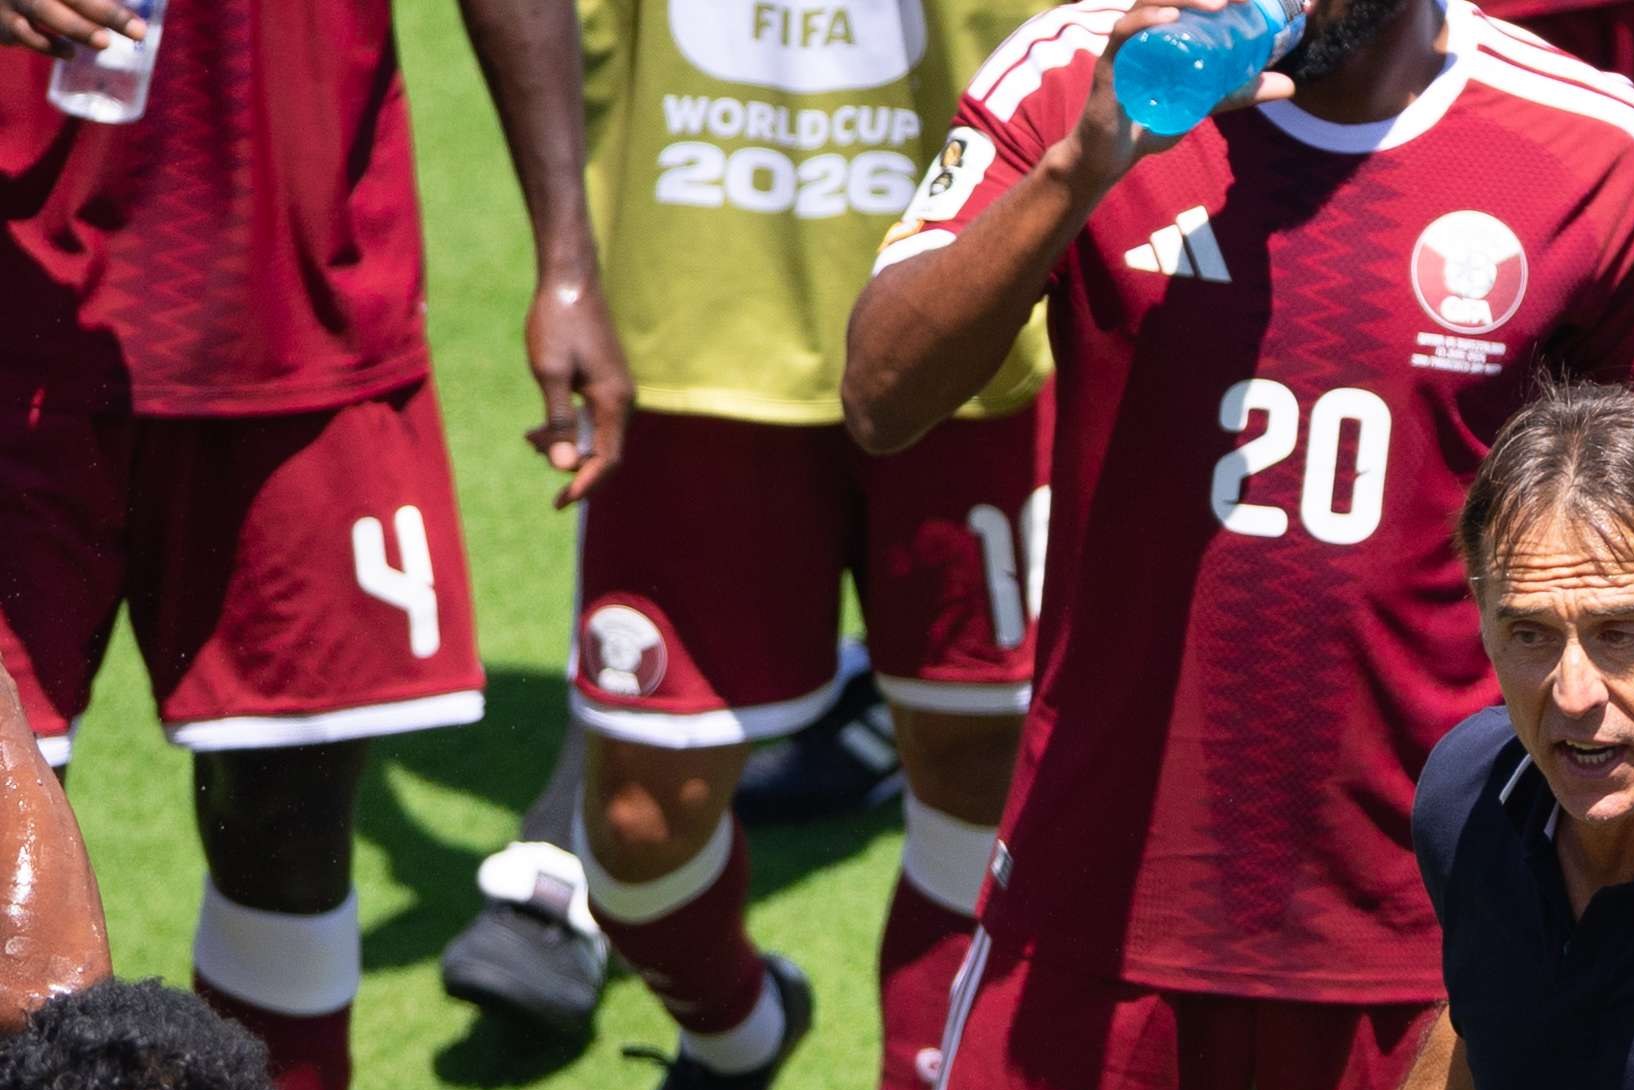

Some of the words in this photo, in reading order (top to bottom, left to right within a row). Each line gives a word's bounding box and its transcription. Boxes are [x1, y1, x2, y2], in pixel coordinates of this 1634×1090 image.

[752, 4, 855, 46] FIFA
[656, 141, 917, 219] 2026
[1210, 378, 1392, 545] 20
[352, 505, 440, 659] 4
